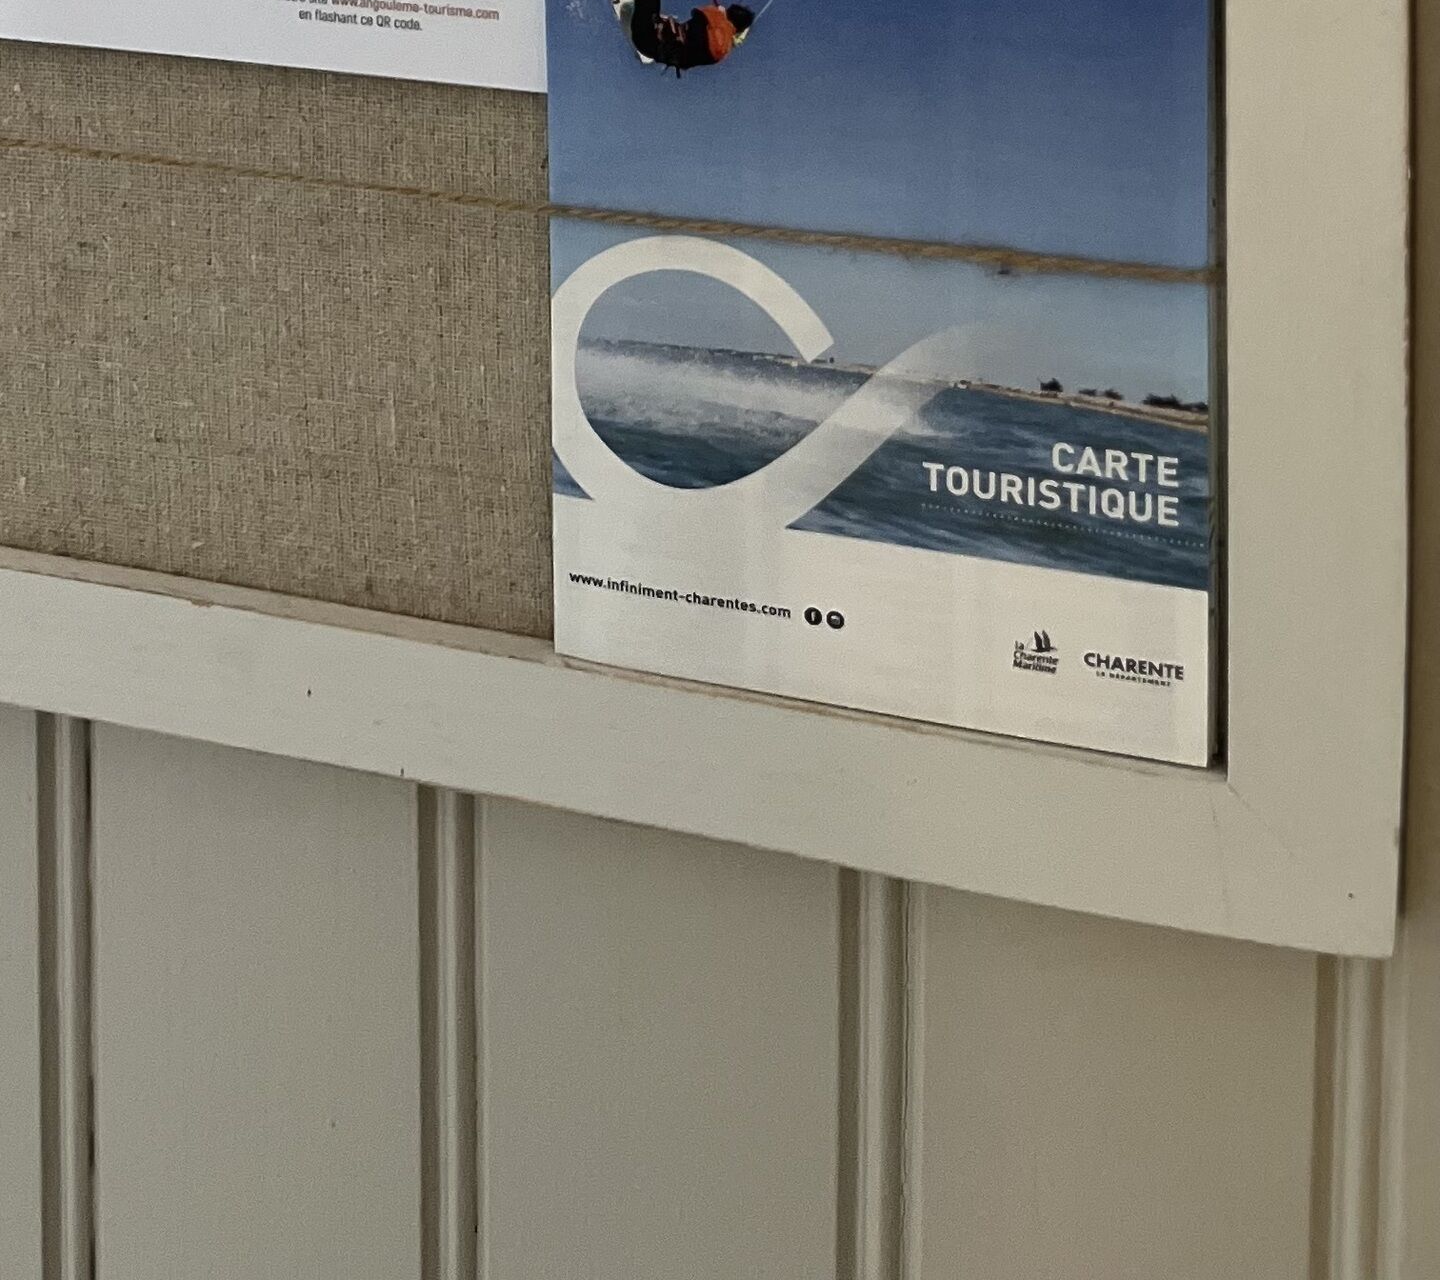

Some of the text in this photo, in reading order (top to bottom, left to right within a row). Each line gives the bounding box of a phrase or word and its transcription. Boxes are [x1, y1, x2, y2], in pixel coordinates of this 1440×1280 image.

[298, 8, 422, 32] en flashant ce QR code.
[1052, 442, 1179, 487] CARTE
[921, 460, 1180, 527] TOURISTIQUE
[568, 571, 792, 619] www.infiniment-charentes.com
[1084, 653, 1184, 681] CHARENTE
